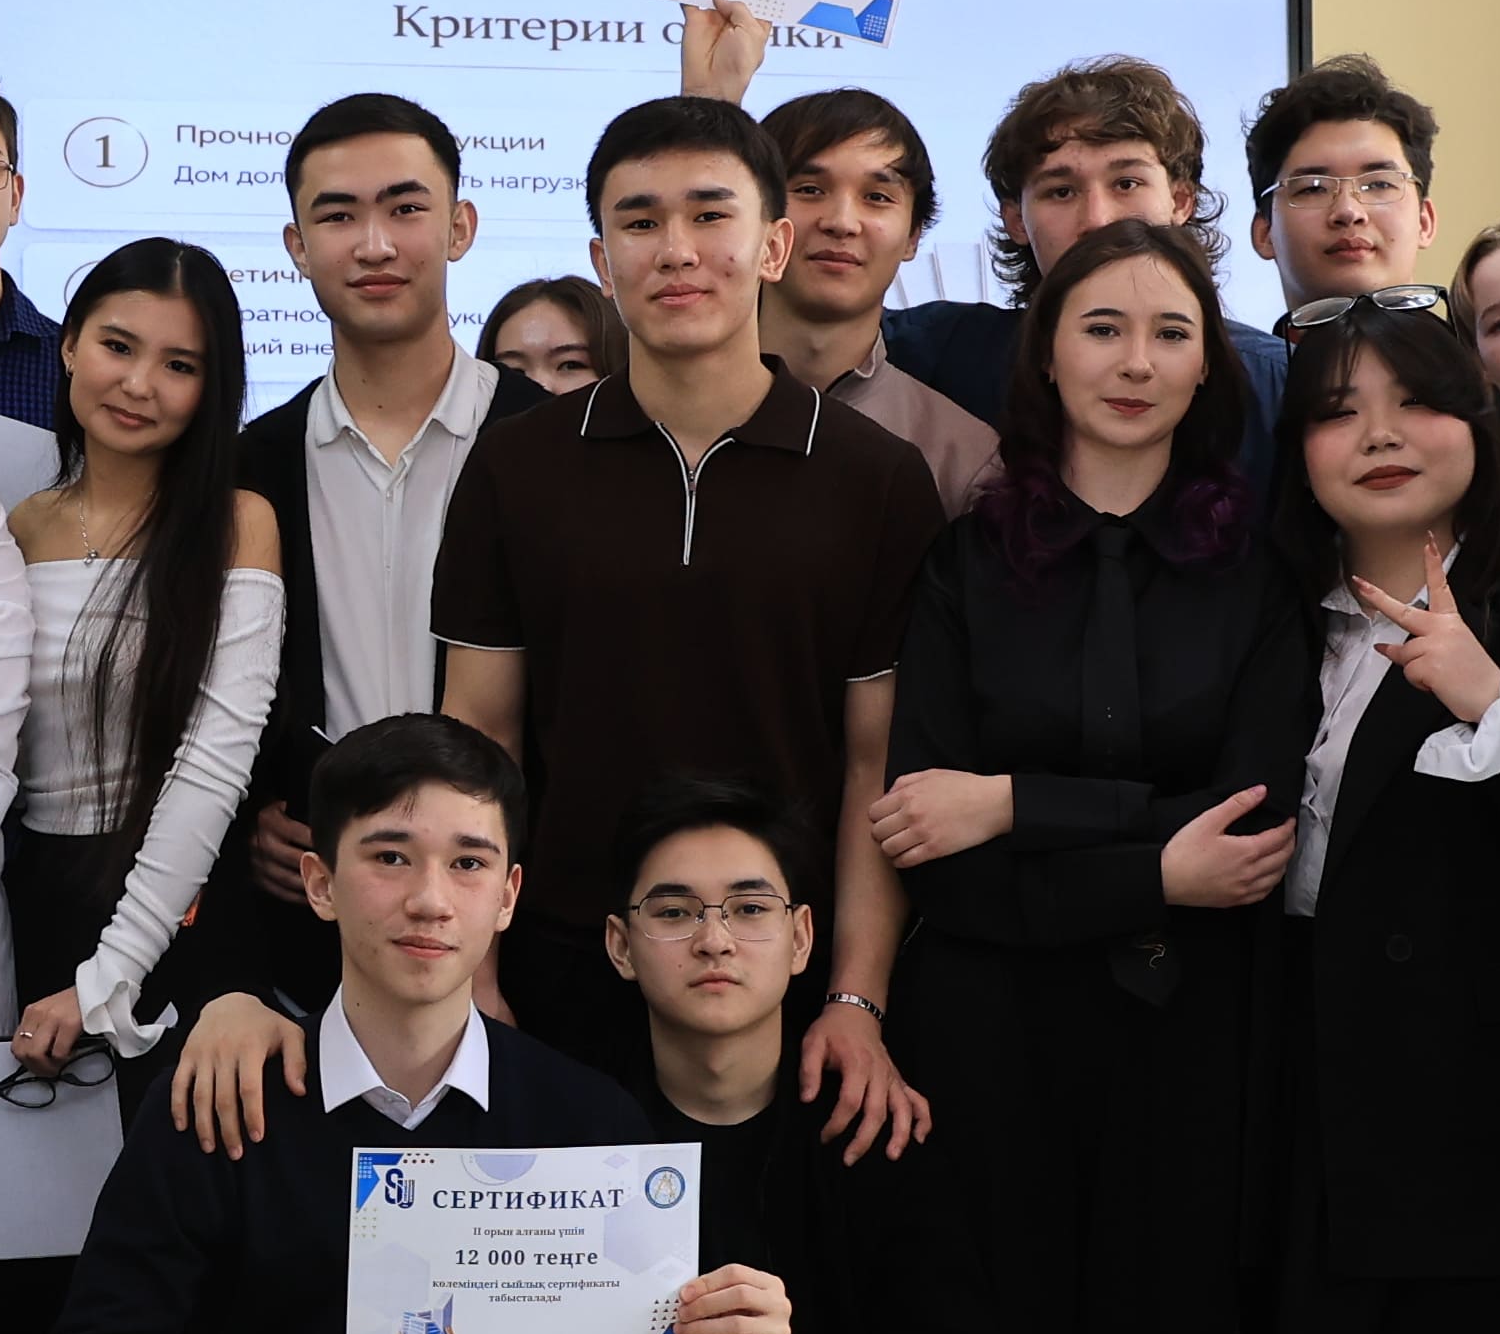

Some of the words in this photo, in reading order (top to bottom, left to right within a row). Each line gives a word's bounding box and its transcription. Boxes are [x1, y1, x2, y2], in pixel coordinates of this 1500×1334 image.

[393, 4, 646, 52] Критерии
[176, 124, 299, 148] Прочно
[95, 133, 117, 169] 1
[174, 165, 229, 185] Дом
[236, 170, 285, 186] дол
[491, 175, 588, 194] нагрузк
[432, 1188, 625, 1210] СЕРТИФИКАТ
[483, 1228, 514, 1238] орын
[455, 1249, 479, 1265] 12
[488, 1249, 525, 1266] 000
[533, 1251, 598, 1268] теңге
[501, 1279, 545, 1290] сыйлық
[547, 1278, 620, 1290] сертификаты
[488, 1293, 561, 1303] табысталады
